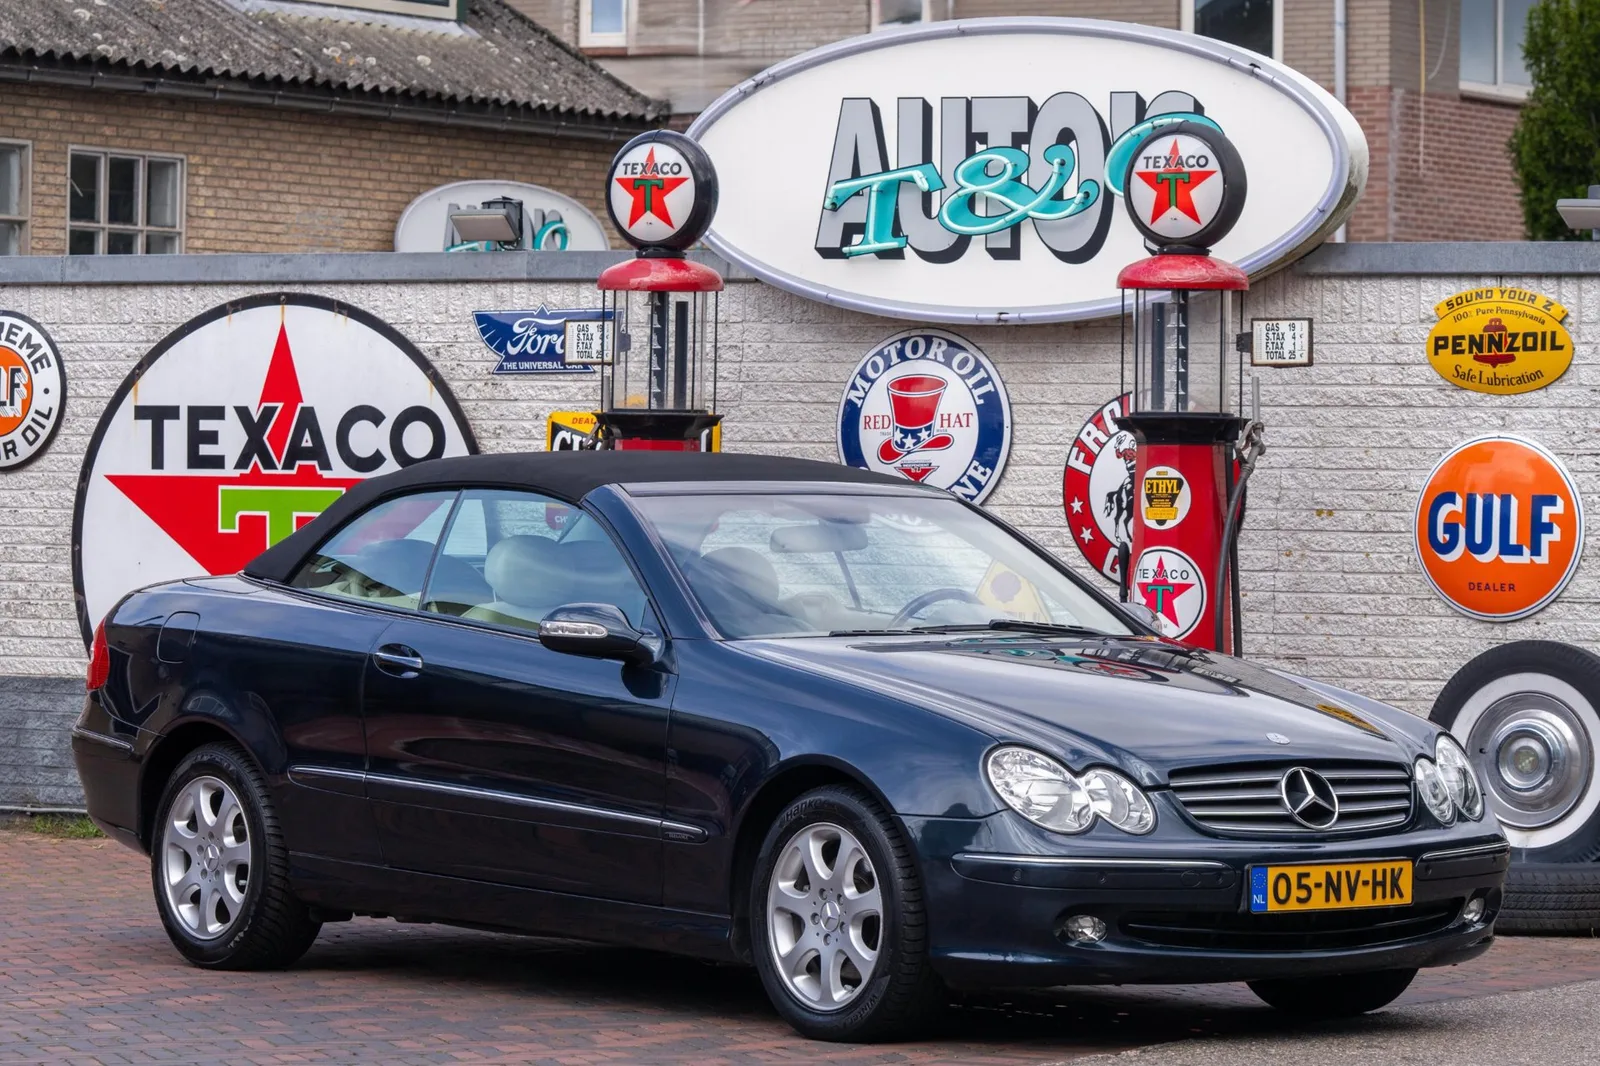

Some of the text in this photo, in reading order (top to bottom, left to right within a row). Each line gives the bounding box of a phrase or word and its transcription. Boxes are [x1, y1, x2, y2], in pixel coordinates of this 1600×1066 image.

[622, 162, 682, 175] TEXACO
[1143, 154, 1209, 169] TEXACO
[814, 90, 1205, 264] AUTO'
[633, 179, 664, 213] T
[1156, 172, 1190, 208] T
[1446, 289, 1555, 311] SOUND YOUR Z
[1476, 308, 1494, 316] Pure
[1495, 306, 1546, 326] Pennsylvania
[576, 323, 590, 333] GAS
[1265, 322, 1279, 331] GAS
[1288, 322, 1296, 331] 19
[576, 332, 594, 341] S.TAX
[1265, 331, 1286, 341] S.TAX
[1292, 332, 1296, 340] 4
[576, 341, 593, 350] F.TAX
[1265, 341, 1285, 351] F.TAX
[1293, 341, 1296, 350] 1
[1433, 331, 1565, 357] PENNZOIL
[576, 350, 594, 359] TOTAL
[1265, 351, 1286, 360] TOTAL
[1288, 351, 1297, 360] 25
[502, 362, 518, 370] THE
[518, 361, 564, 370] UNIVERSAL
[847, 336, 996, 409] MOTOR OIL
[1452, 364, 1545, 387] Safe Lubrication
[21, 406, 53, 447] OIL
[571, 417, 597, 425] DEAL
[863, 412, 974, 430] RED HAT
[134, 404, 447, 472] TEXACO
[1145, 479, 1180, 494] ETHYL
[1428, 491, 1562, 561] GULF
[1468, 581, 1516, 592] DEALER
[1148, 585, 1174, 614] T
[1272, 867, 1404, 905] 05-NV-HK
[1253, 894, 1265, 904] NL
